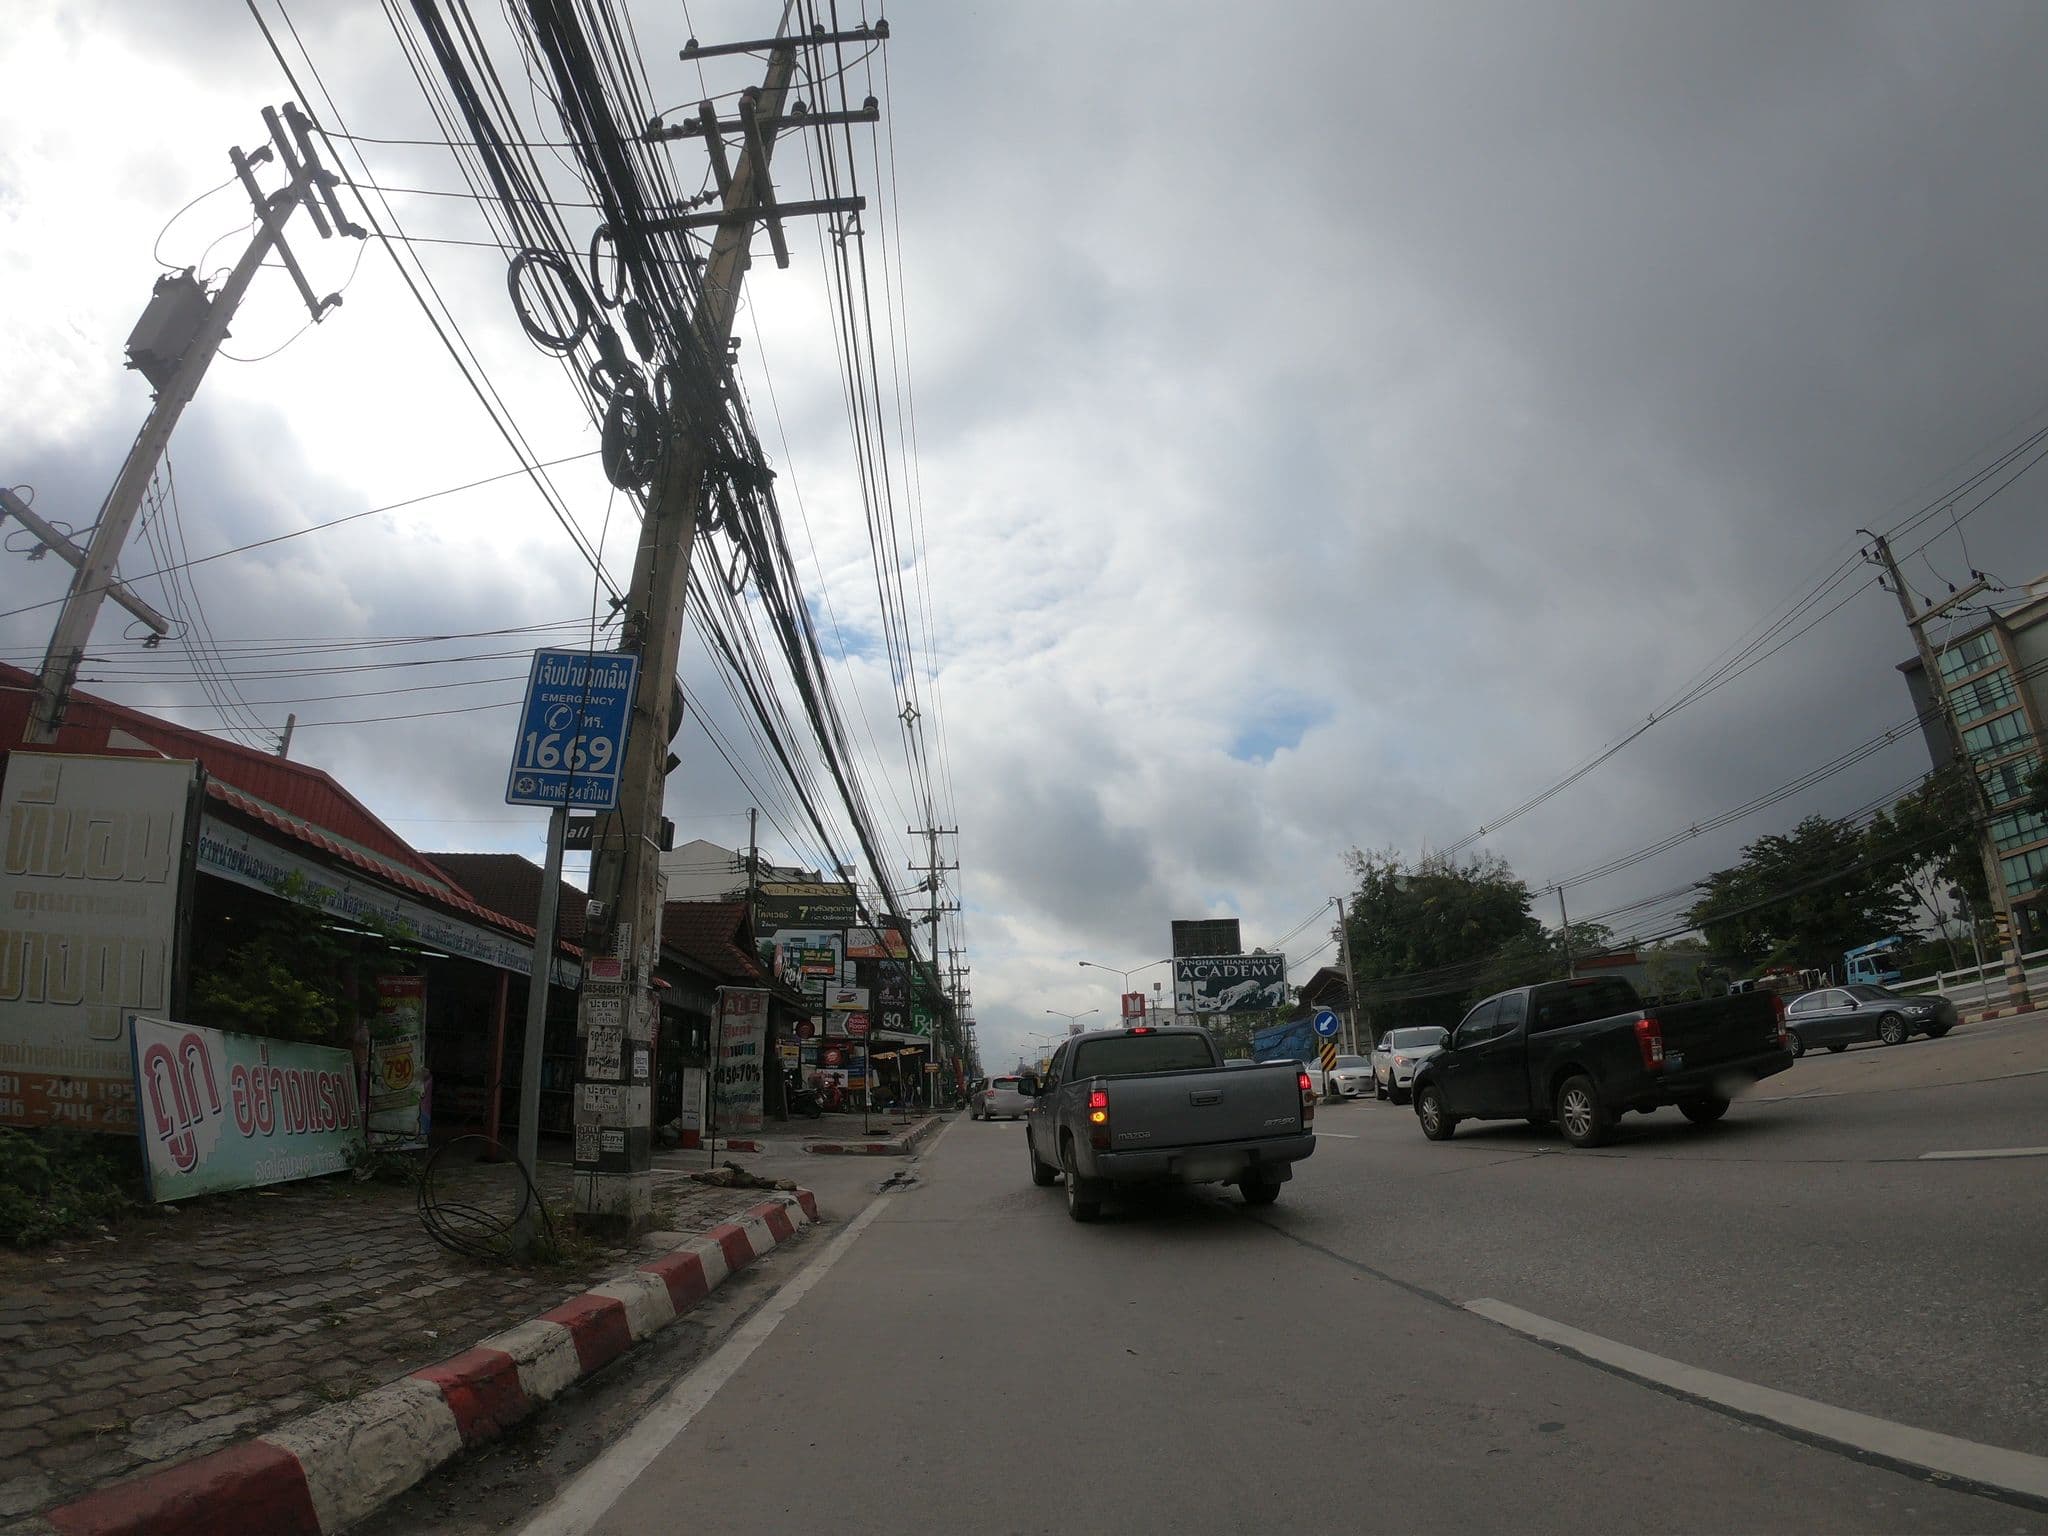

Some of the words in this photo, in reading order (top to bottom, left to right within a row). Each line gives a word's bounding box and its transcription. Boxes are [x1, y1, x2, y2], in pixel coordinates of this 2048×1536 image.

[541, 692, 617, 707] EMERGENCY
[526, 731, 613, 772] 1669
[568, 786, 582, 800] 24
[1180, 963, 1281, 978] ACADEMY
[145, 1033, 222, 1173] ถูก
[1118, 1131, 1151, 1141] mazda
